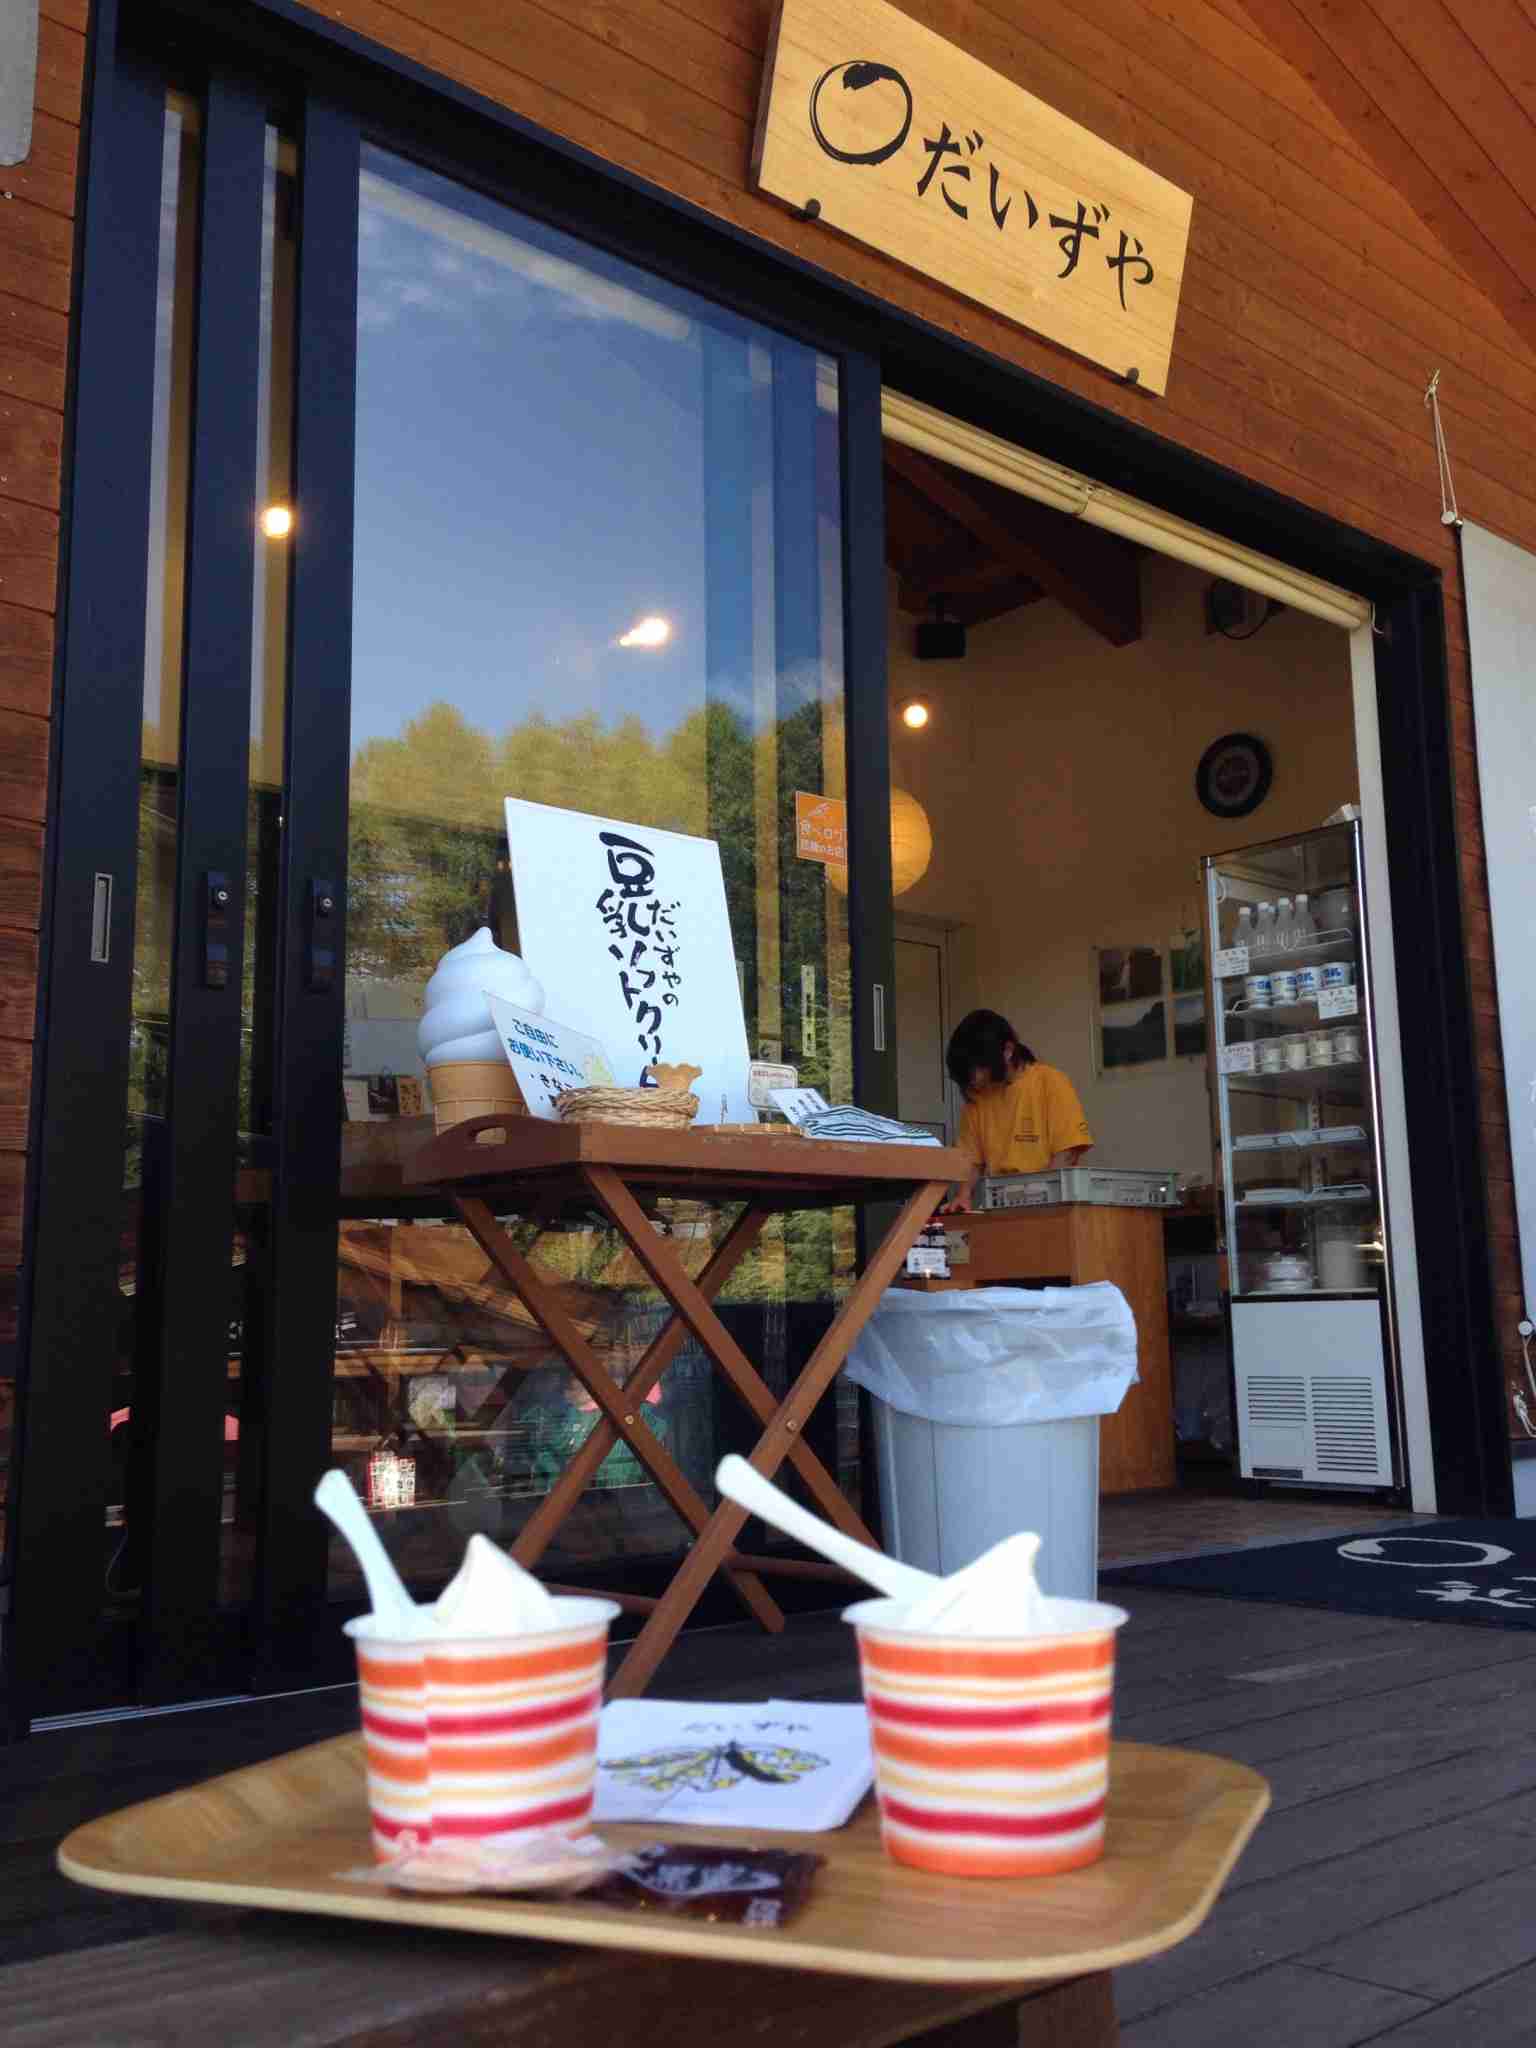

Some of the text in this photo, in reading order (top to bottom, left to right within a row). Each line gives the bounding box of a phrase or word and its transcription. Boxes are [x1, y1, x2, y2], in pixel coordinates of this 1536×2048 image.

[916, 121, 1154, 312] だいずや
[646, 899, 682, 1008] だいずやの
